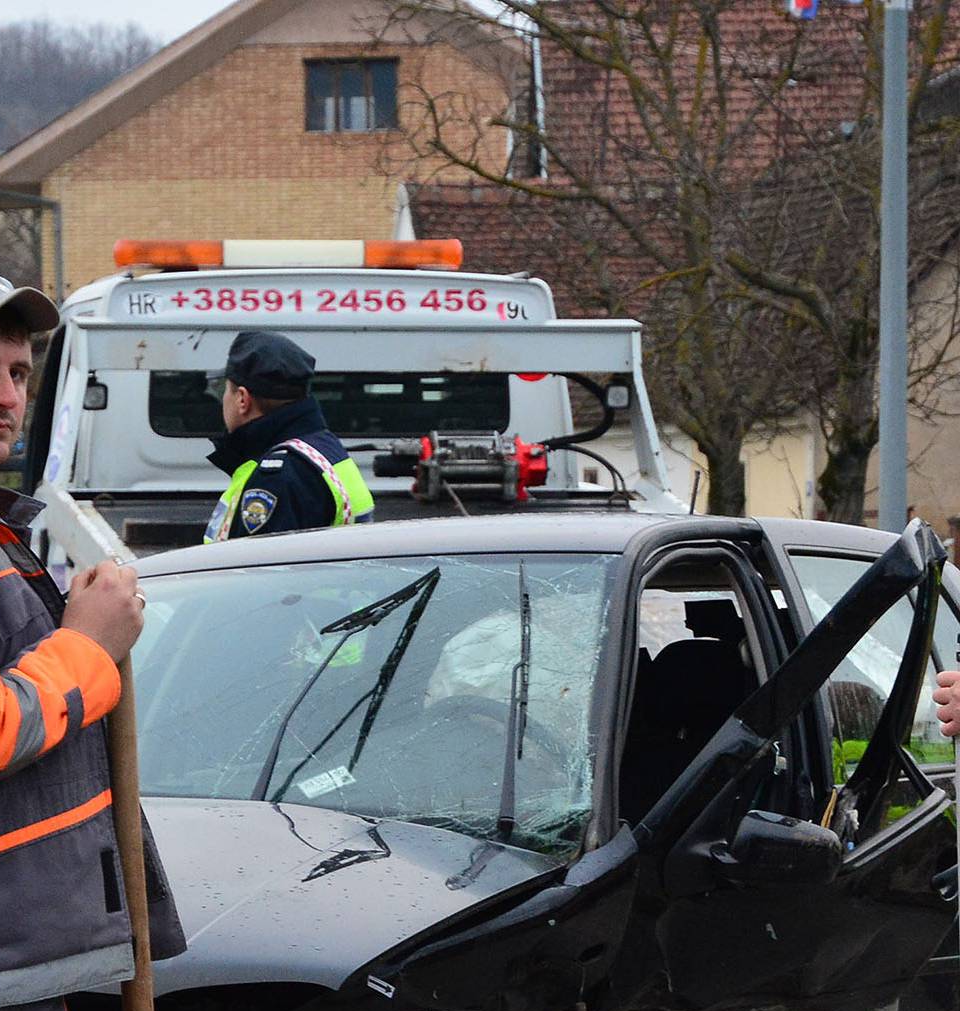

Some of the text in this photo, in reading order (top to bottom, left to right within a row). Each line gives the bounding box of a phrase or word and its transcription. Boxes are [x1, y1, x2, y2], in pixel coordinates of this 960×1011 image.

[128, 293, 156, 314] HR
[171, 288, 488, 312] +38591 2456 456
